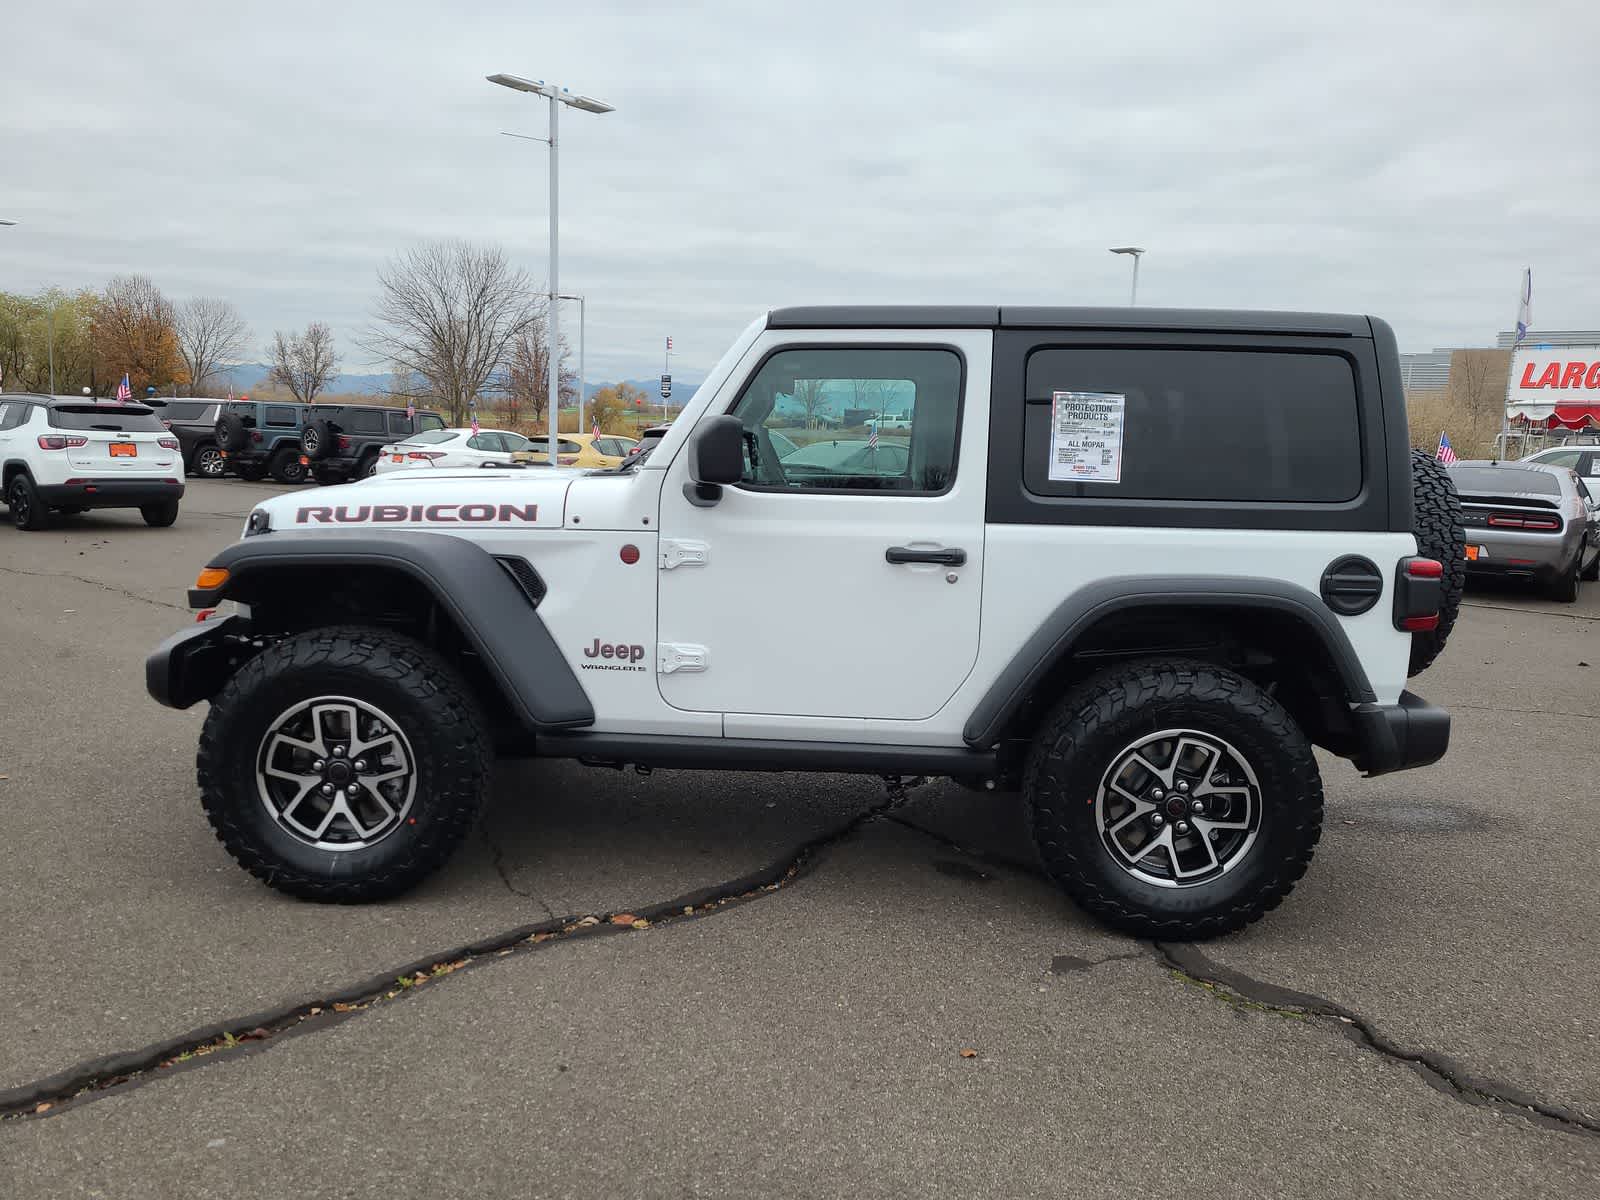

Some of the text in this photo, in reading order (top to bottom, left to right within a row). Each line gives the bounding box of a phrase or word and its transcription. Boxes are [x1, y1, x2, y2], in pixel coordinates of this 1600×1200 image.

[1065, 403, 1112, 413] PROTECTION
[1068, 412, 1108, 421] PRODUCTS
[1068, 440, 1105, 448] ALL MOPAR
[295, 504, 538, 523] RUBICON
[583, 638, 645, 663] Jeep
